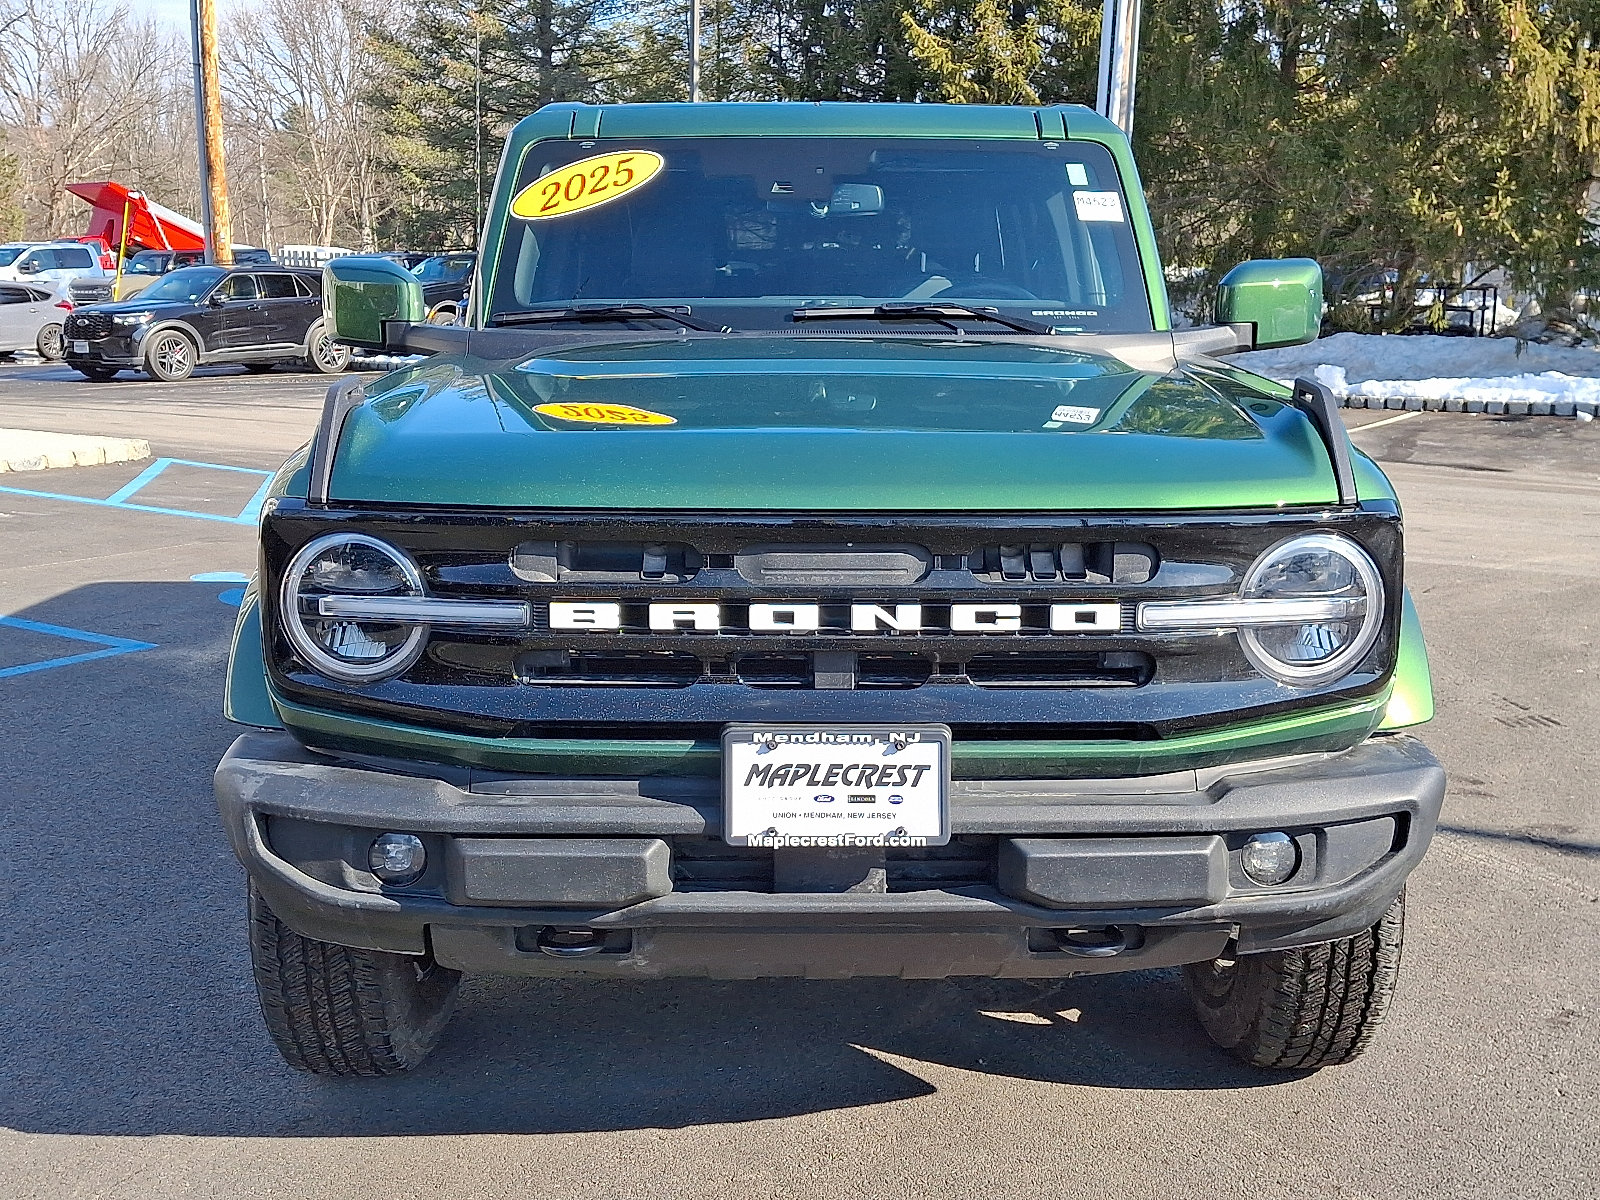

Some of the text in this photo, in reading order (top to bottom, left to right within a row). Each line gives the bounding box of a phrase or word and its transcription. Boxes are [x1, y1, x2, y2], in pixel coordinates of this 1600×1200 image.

[540, 157, 635, 212] 2025
[549, 602, 1121, 632] BRONCO
[753, 732, 921, 745] Mendham, NJ
[744, 763, 932, 789] MAPLECREST
[748, 833, 927, 849] MaplecrestFord.com
